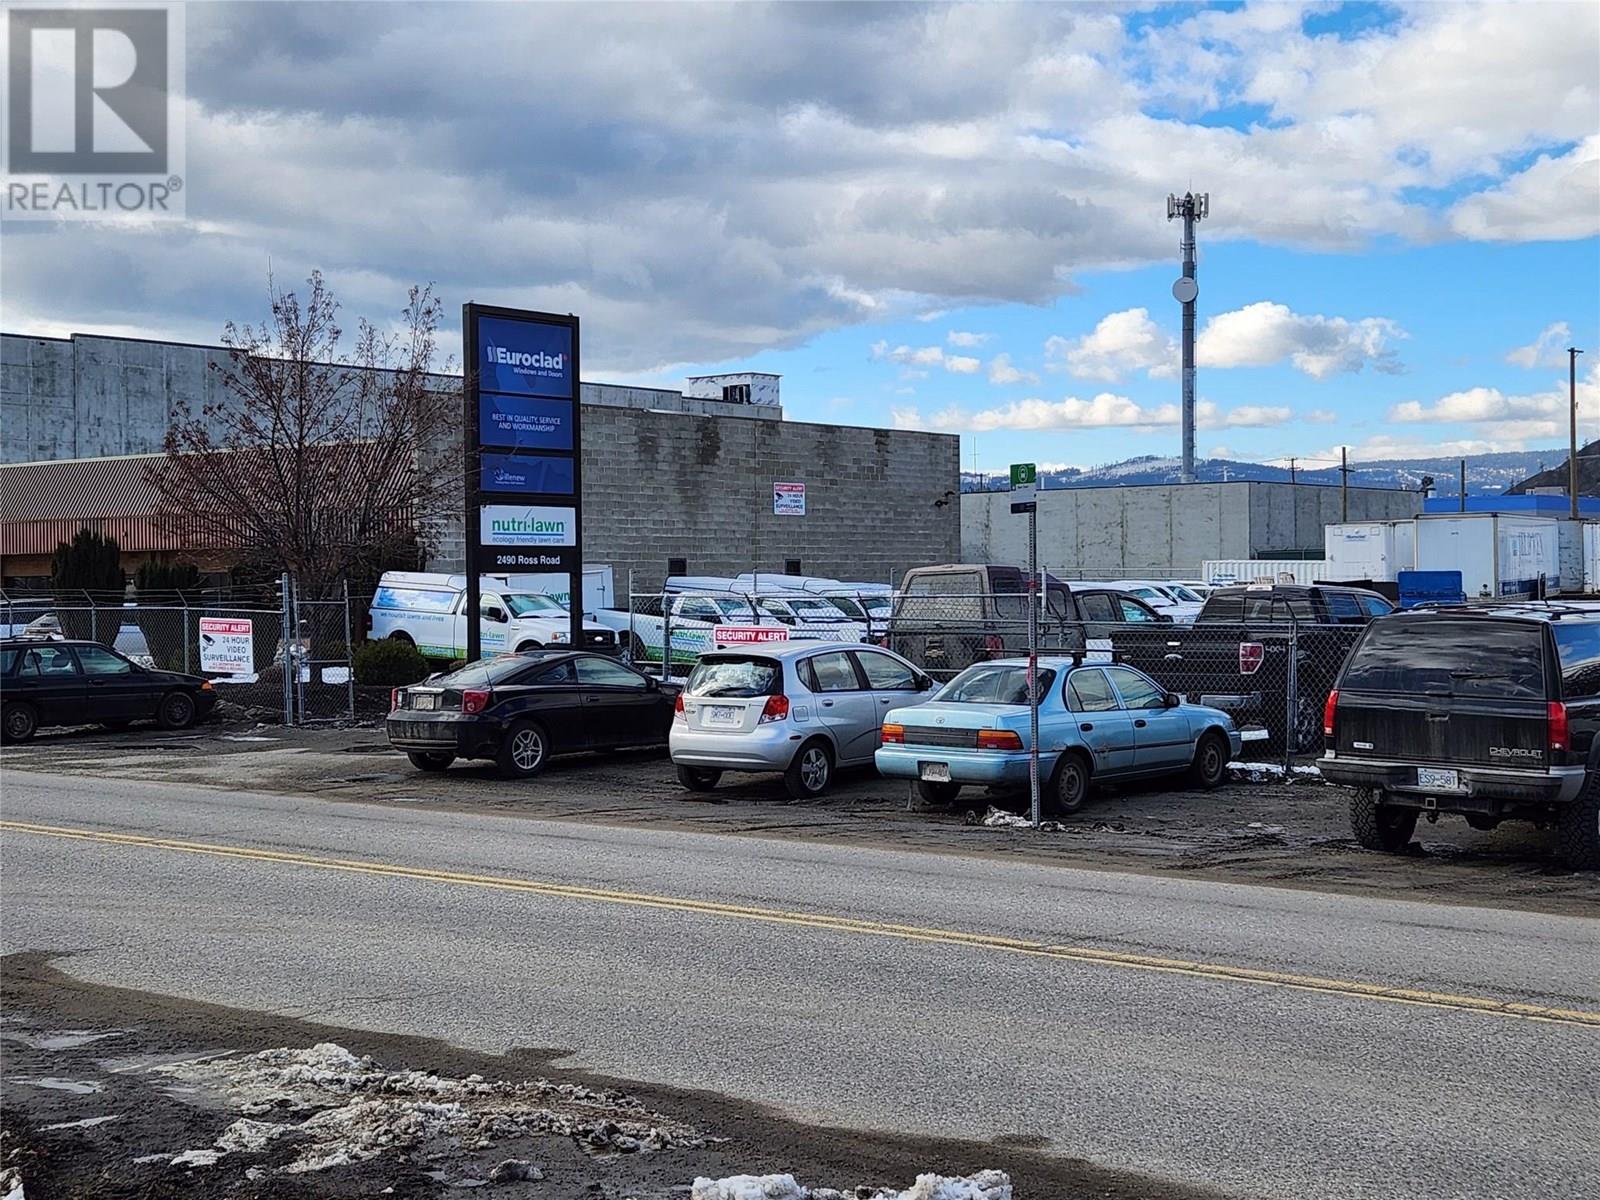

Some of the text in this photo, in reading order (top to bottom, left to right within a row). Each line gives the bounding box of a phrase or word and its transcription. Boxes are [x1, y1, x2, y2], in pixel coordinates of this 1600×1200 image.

[496, 347, 563, 369] Euroclad
[513, 367, 537, 375] Windows
[492, 413, 505, 421] BEST
[539, 417, 561, 425] SERVICE
[498, 422, 556, 432] AND WORKMANSHIP
[492, 537, 515, 545] ecology
[516, 536, 537, 544] friendly
[496, 555, 561, 565] 2490 Ross Road
[202, 623, 230, 631] SECURITY
[222, 636, 250, 644] 24 HOUR
[716, 631, 786, 641] SECURITY ALERT
[227, 646, 246, 654] VIDEO
[203, 653, 250, 663] SURVEILLANCE
[1489, 746, 1543, 758] CHEVROLET
